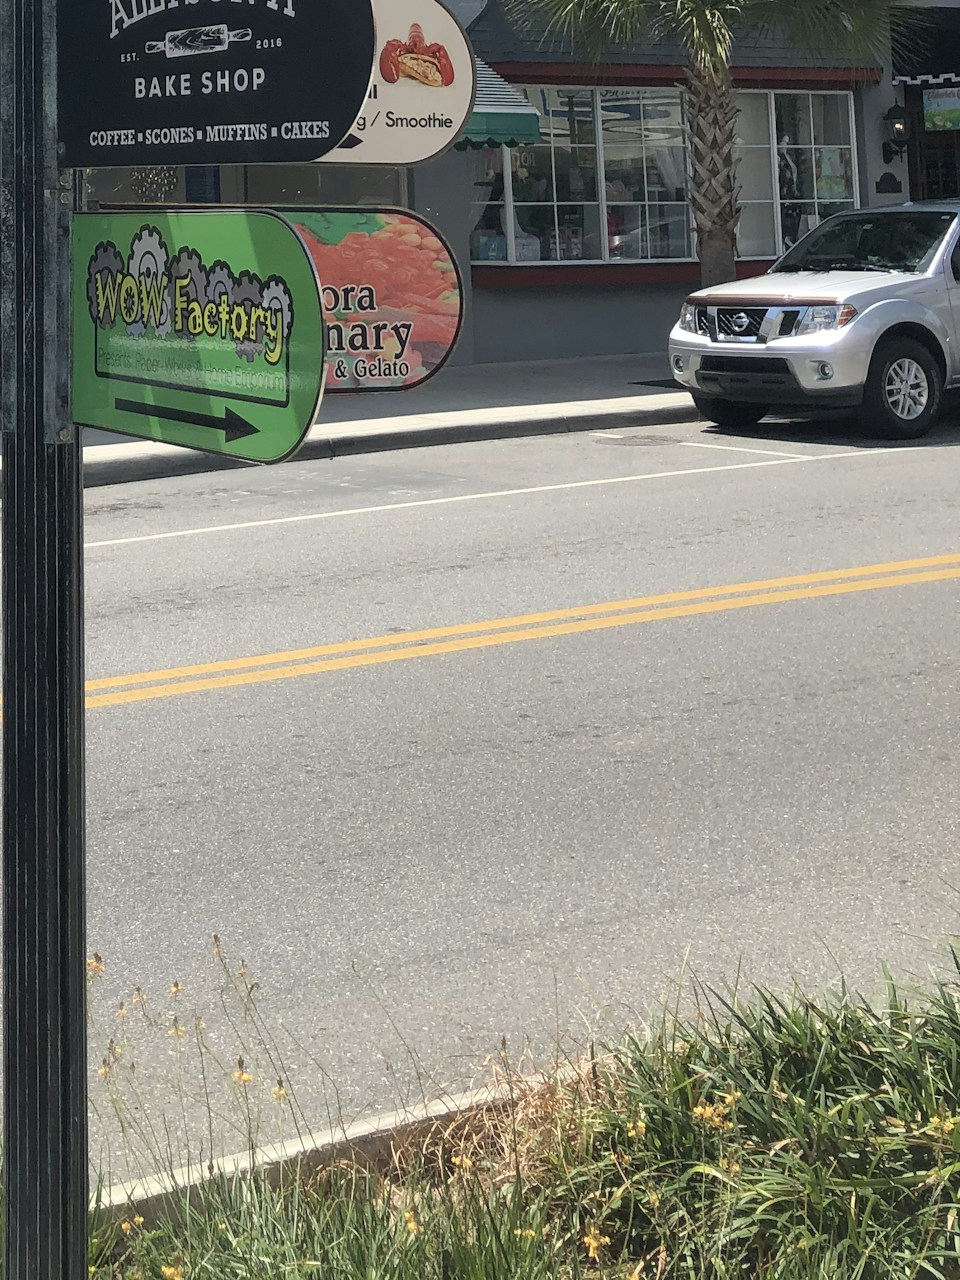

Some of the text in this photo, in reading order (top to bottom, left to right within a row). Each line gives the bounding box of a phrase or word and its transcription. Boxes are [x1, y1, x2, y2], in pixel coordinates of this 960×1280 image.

[120, 37, 283, 64] EST. 2016
[134, 67, 266, 99] BAKE SHOP
[385, 110, 453, 128] Smoothie
[89, 120, 330, 147] COFFEE SCONES MUFFINS CAKES
[174, 272, 283, 366] Factory
[334, 357, 409, 379] & Gelato
